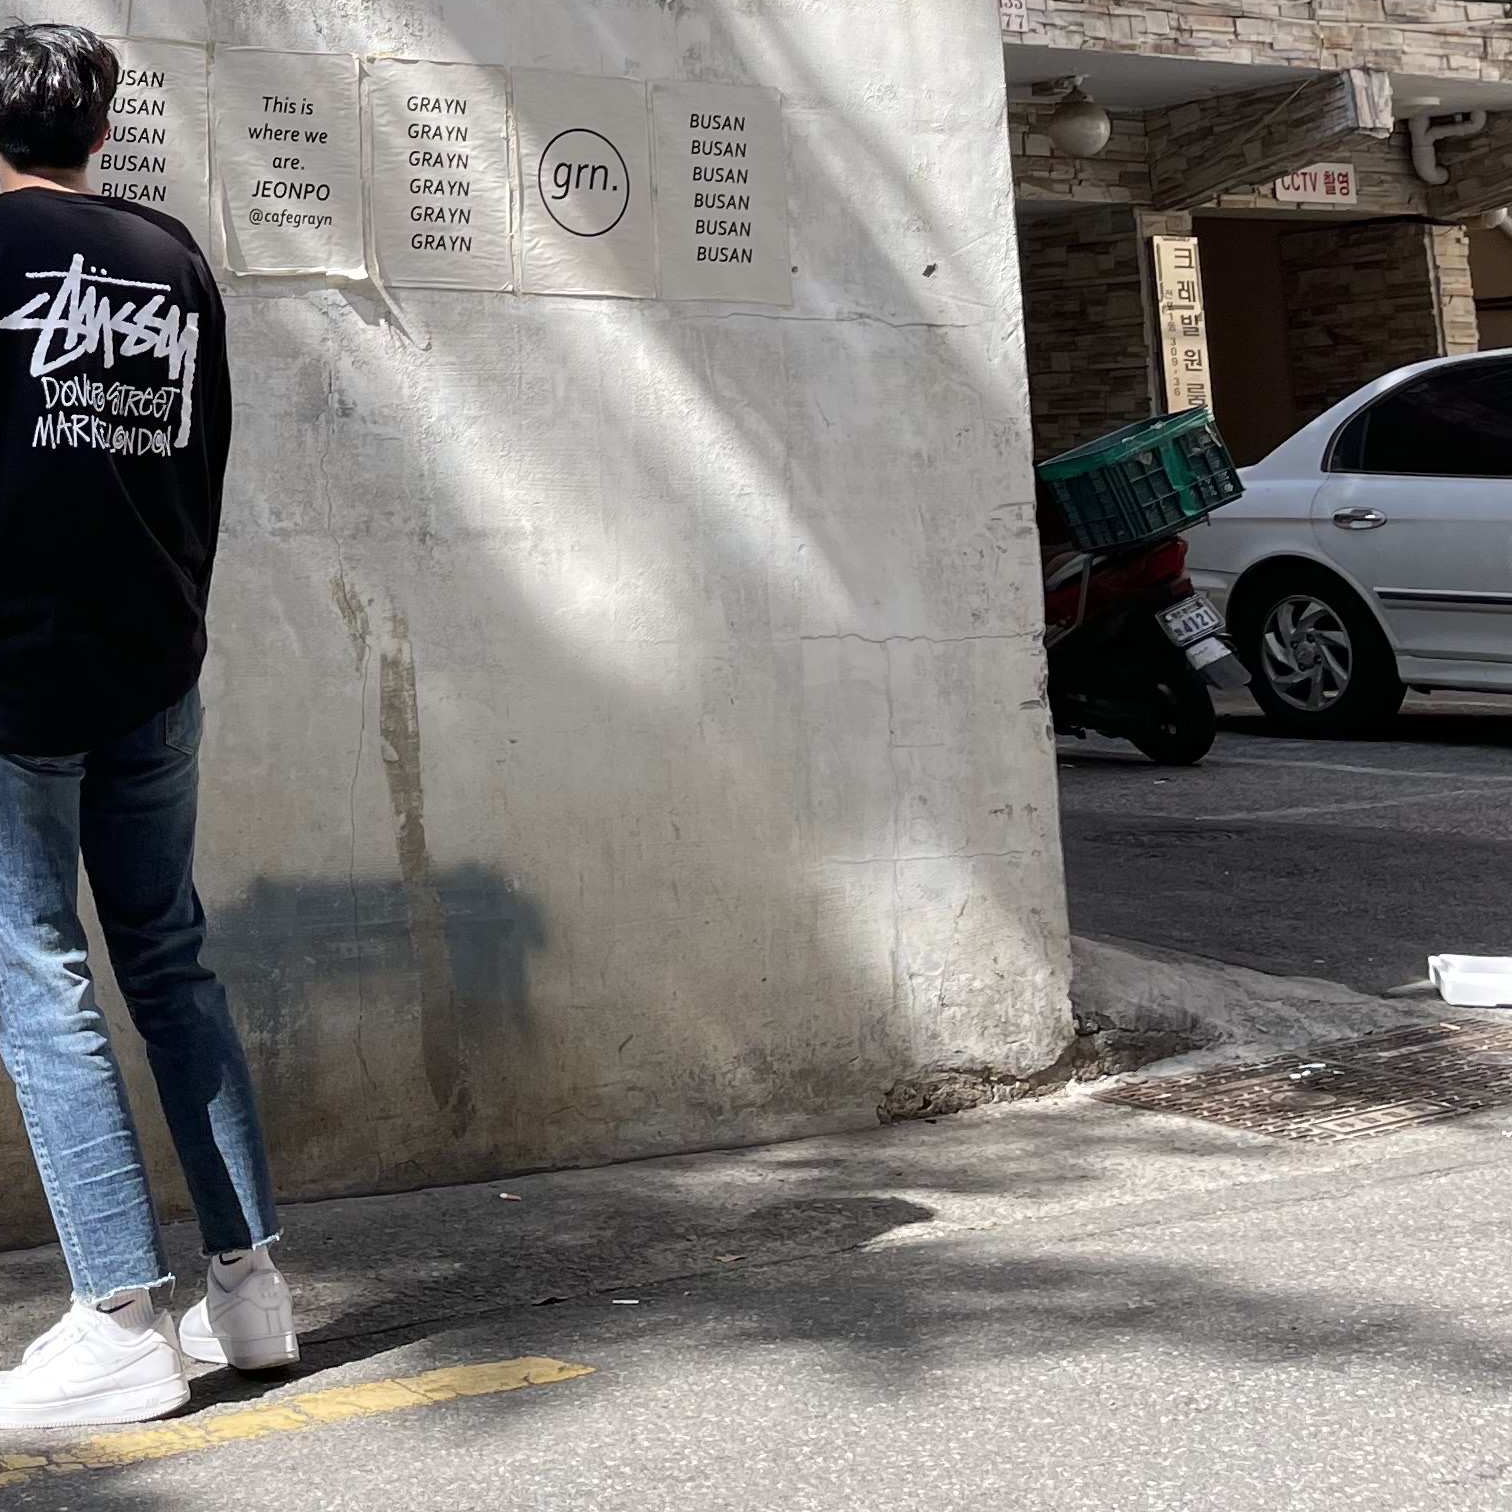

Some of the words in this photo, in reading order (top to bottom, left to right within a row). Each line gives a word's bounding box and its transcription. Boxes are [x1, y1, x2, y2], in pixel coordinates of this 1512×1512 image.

[116, 70, 165, 88] USAN
[111, 97, 166, 116] USAN
[262, 95, 297, 114] This
[300, 97, 314, 116] is
[406, 96, 467, 115] GRAYN
[689, 113, 746, 132] BUSAN
[248, 122, 300, 142] where
[304, 130, 328, 144] we
[407, 123, 468, 142] GRAYN
[691, 139, 747, 158] BUSAN
[100, 153, 166, 174] BUSAN
[272, 156, 305, 171] are.
[408, 150, 469, 170] GRAYN
[552, 161, 618, 199] grn.
[692, 166, 749, 184] BUSAN
[1281, 171, 1318, 192] CCTV
[101, 182, 167, 202] BUSAN
[251, 180, 331, 202] JEONPO
[409, 178, 470, 197] GRAYN
[694, 192, 750, 210] BUSAN
[248, 208, 333, 230] @cafegrayn
[410, 205, 471, 225] GRAYN
[695, 219, 751, 237] BUSAN
[411, 233, 472, 252] GRAYN
[696, 246, 753, 264] BUSAN
